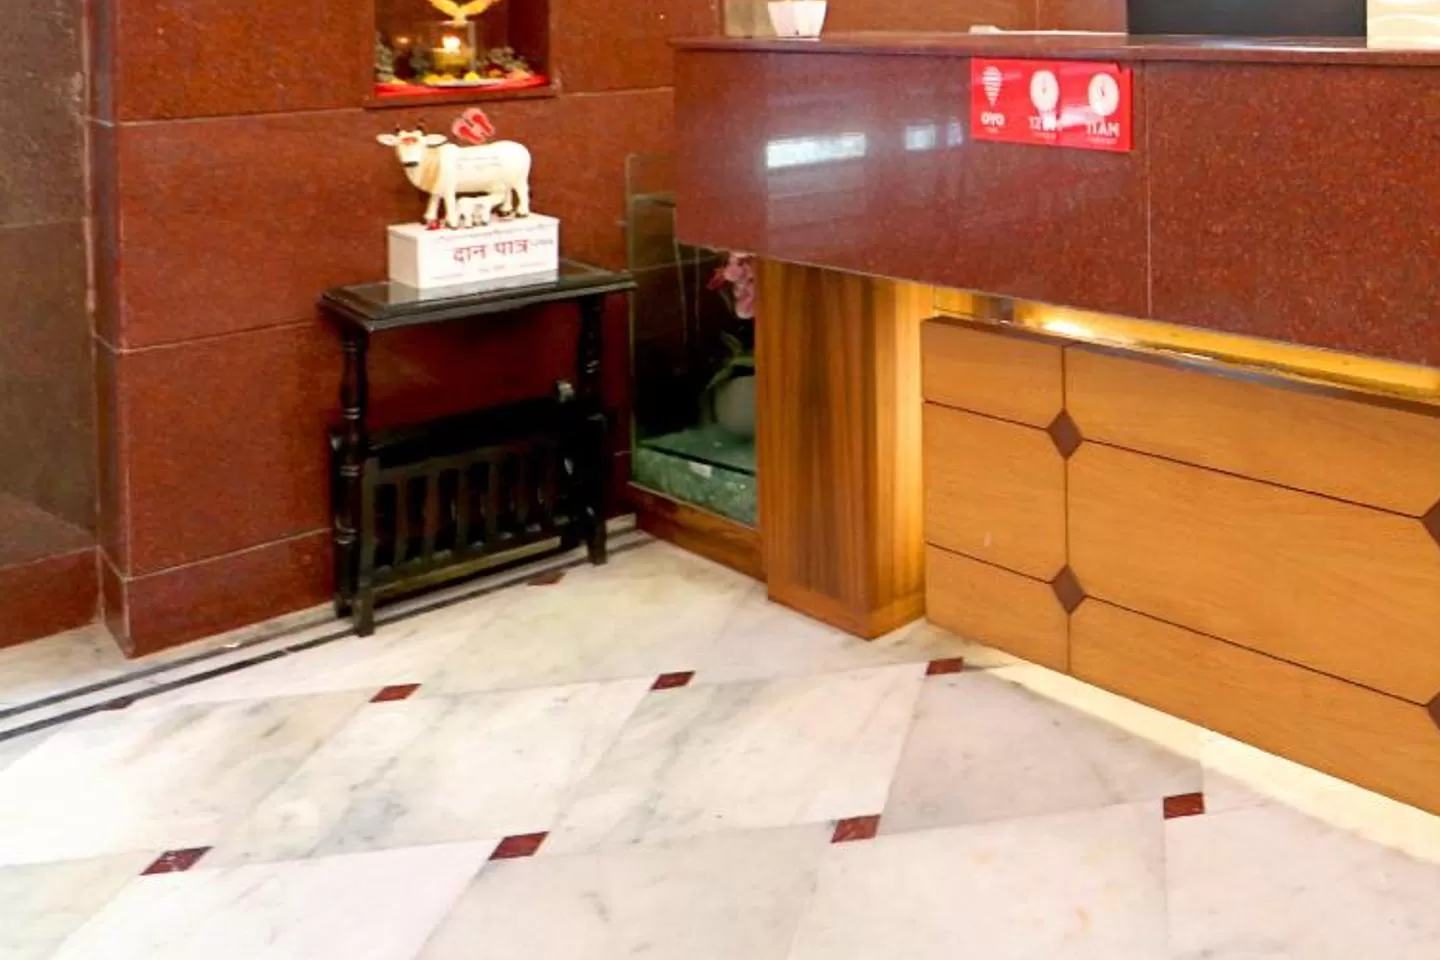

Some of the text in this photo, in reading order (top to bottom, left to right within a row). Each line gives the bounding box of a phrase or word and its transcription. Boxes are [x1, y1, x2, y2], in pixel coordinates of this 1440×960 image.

[981, 112, 1005, 127] OYO
[453, 239, 530, 264] दान पात्र
